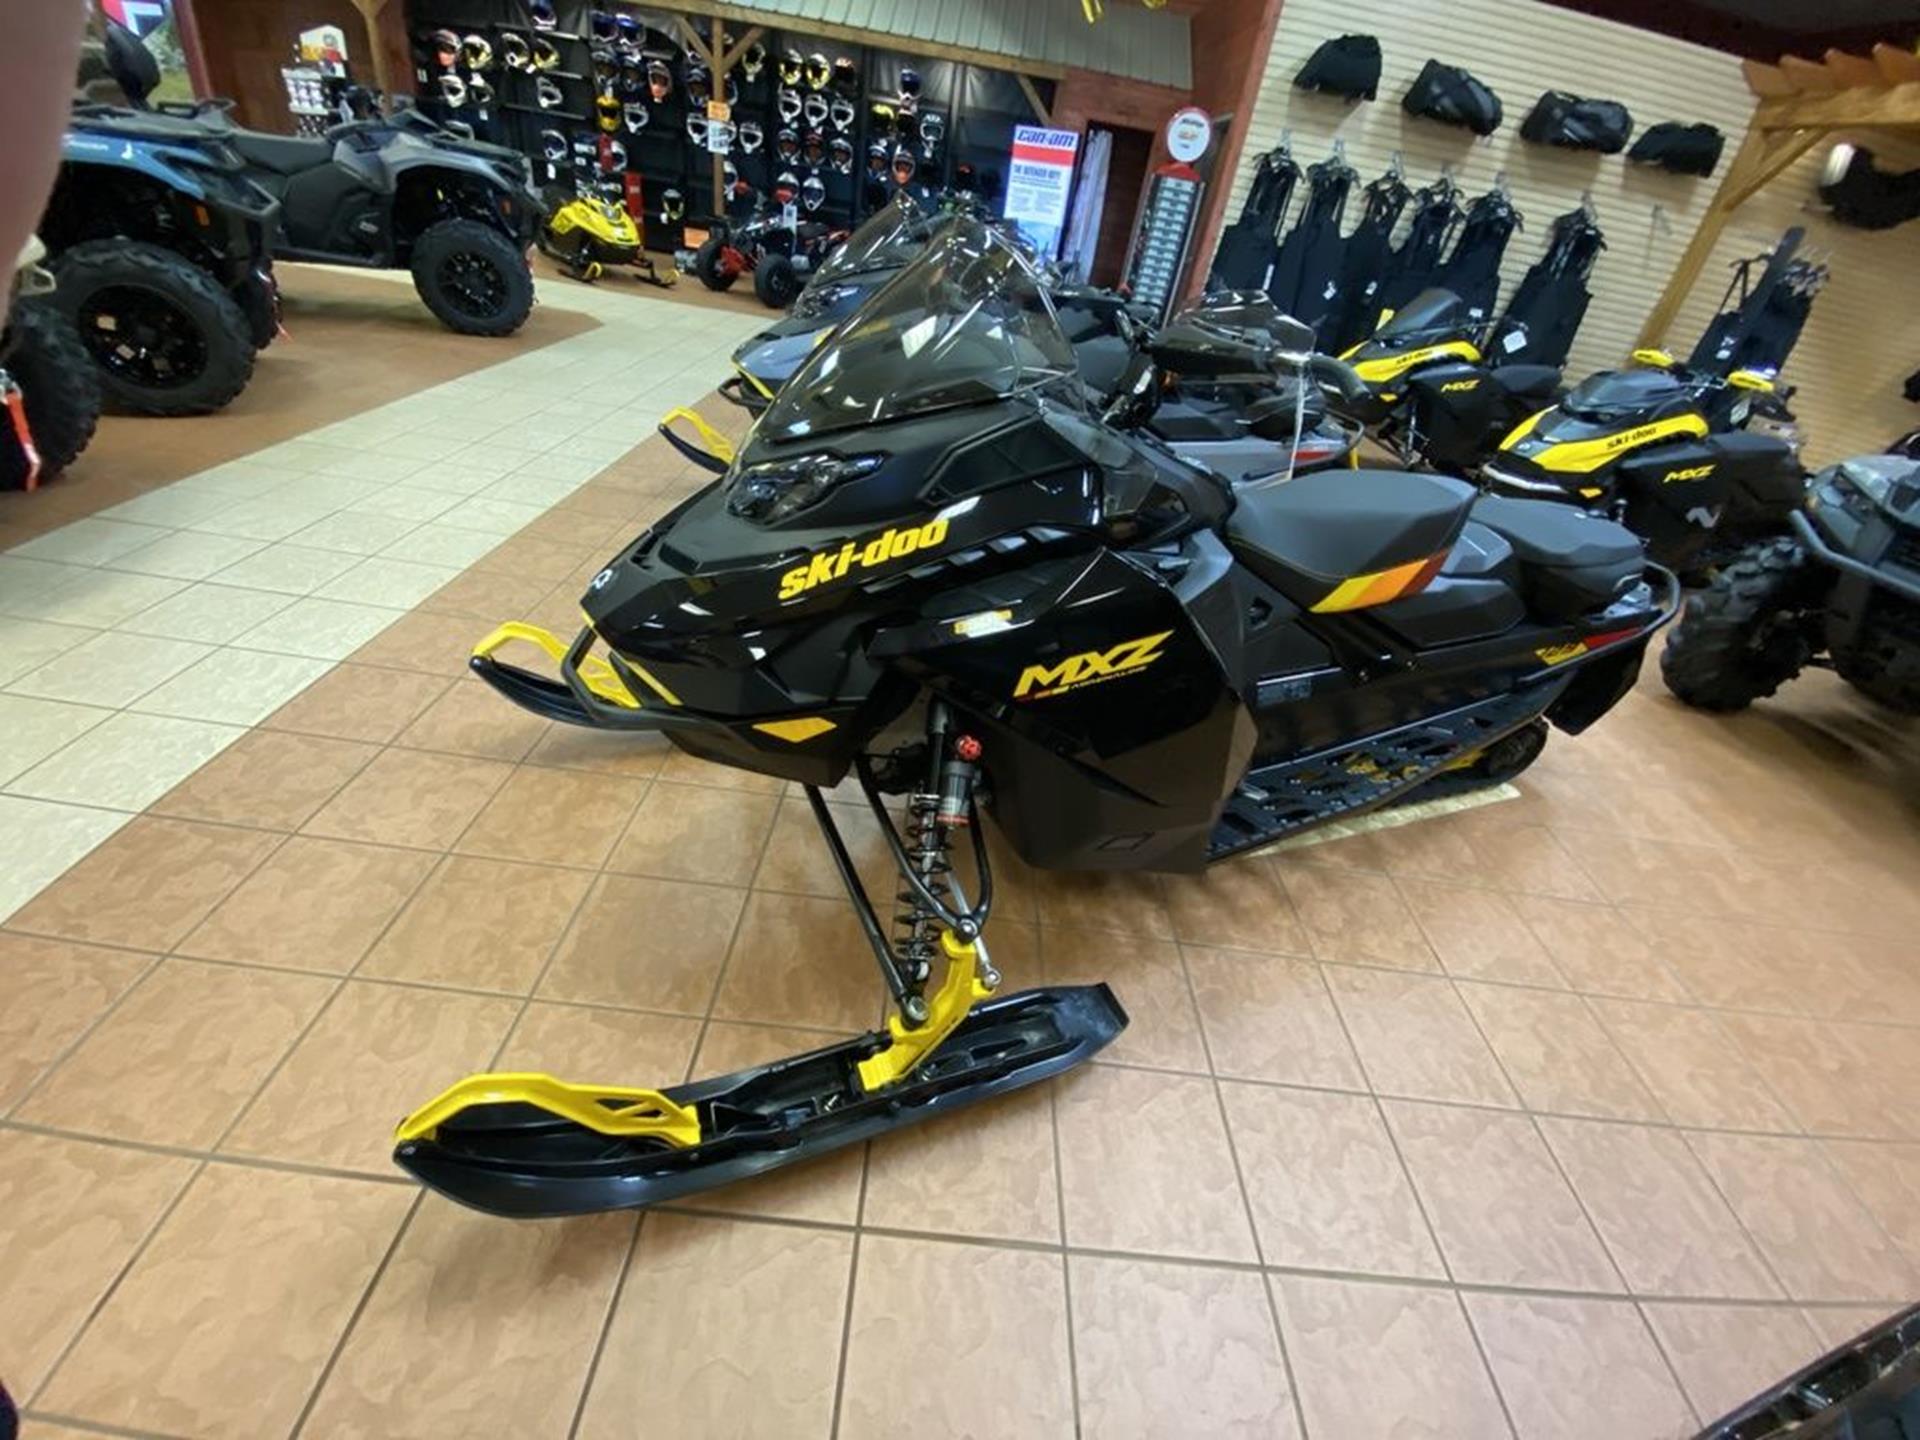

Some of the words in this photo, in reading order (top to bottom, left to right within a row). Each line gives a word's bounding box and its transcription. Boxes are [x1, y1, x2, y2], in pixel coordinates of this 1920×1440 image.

[1017, 129, 1075, 147] can-am
[1607, 427, 1657, 449] ski-doo
[1663, 464, 1717, 483] MXZ
[778, 519, 949, 600] ski-doo
[1013, 629, 1174, 698] MXZ
